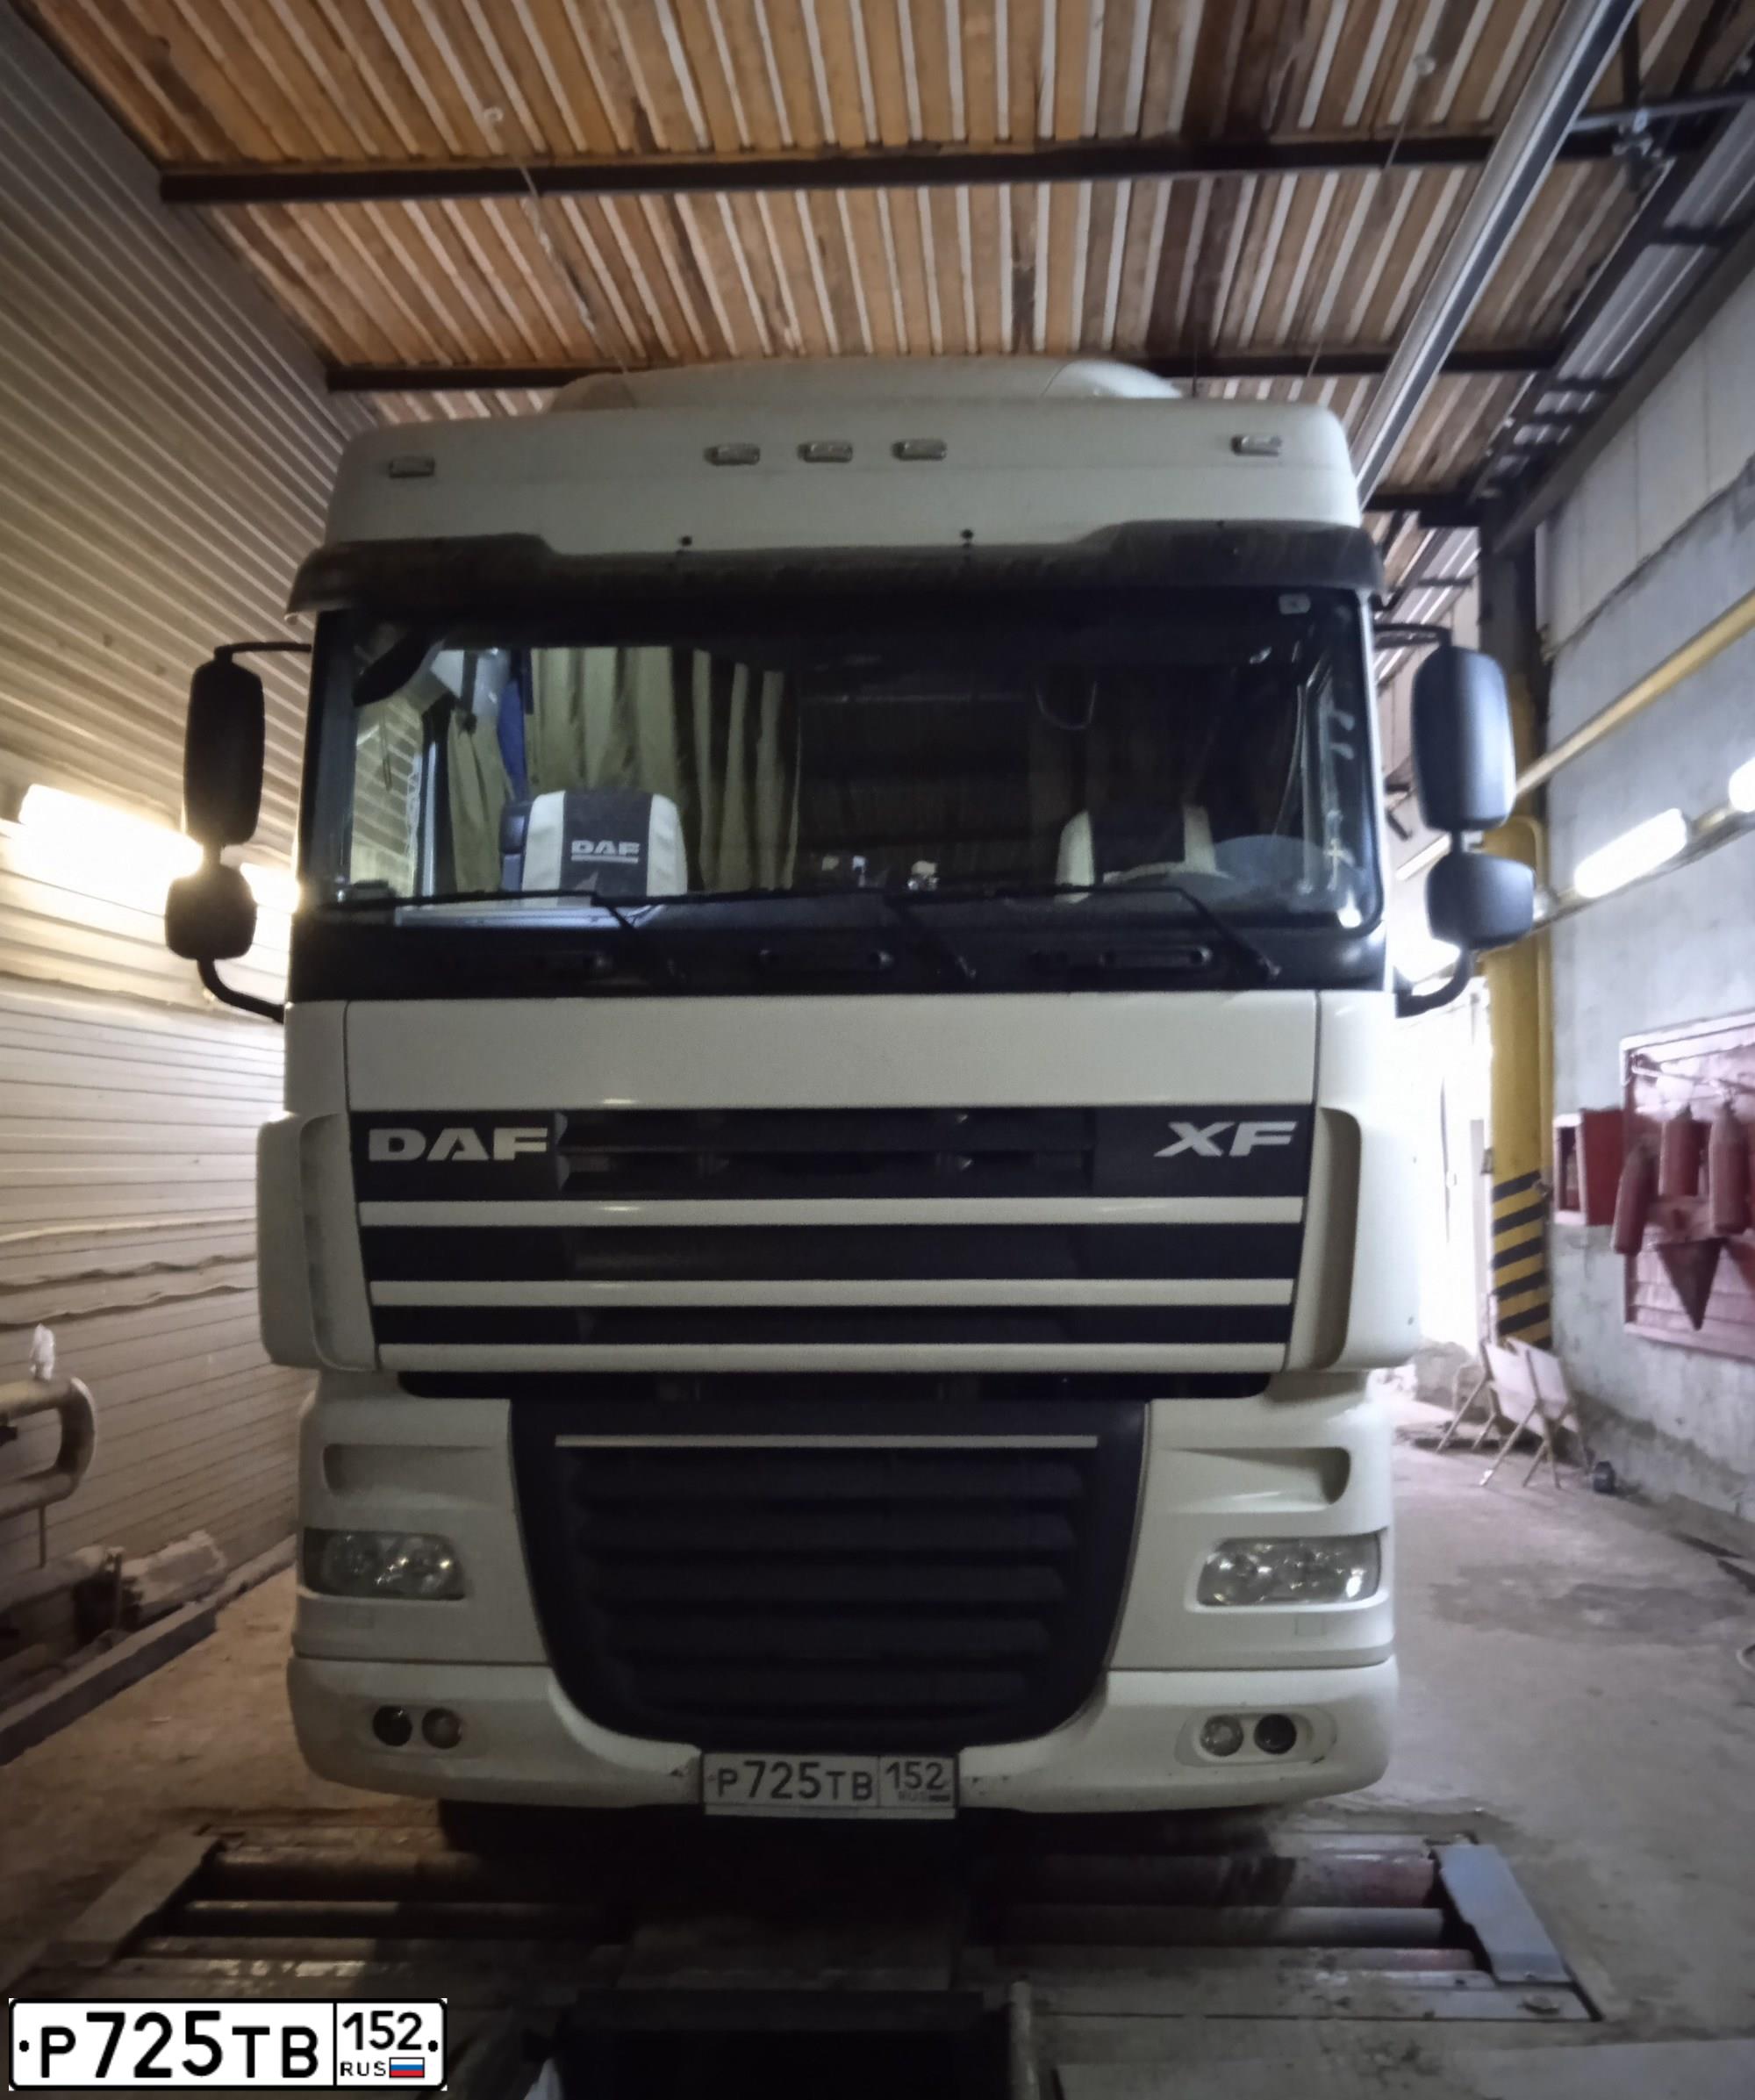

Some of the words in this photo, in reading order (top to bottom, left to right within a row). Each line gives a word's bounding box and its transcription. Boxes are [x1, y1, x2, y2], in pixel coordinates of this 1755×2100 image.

[571, 840, 640, 856] DAF
[369, 1128, 548, 1161] DAF
[1154, 1122, 1297, 1158] XF
[717, 1760, 873, 1801] Р725ТВ
[885, 1760, 945, 1791] 152
